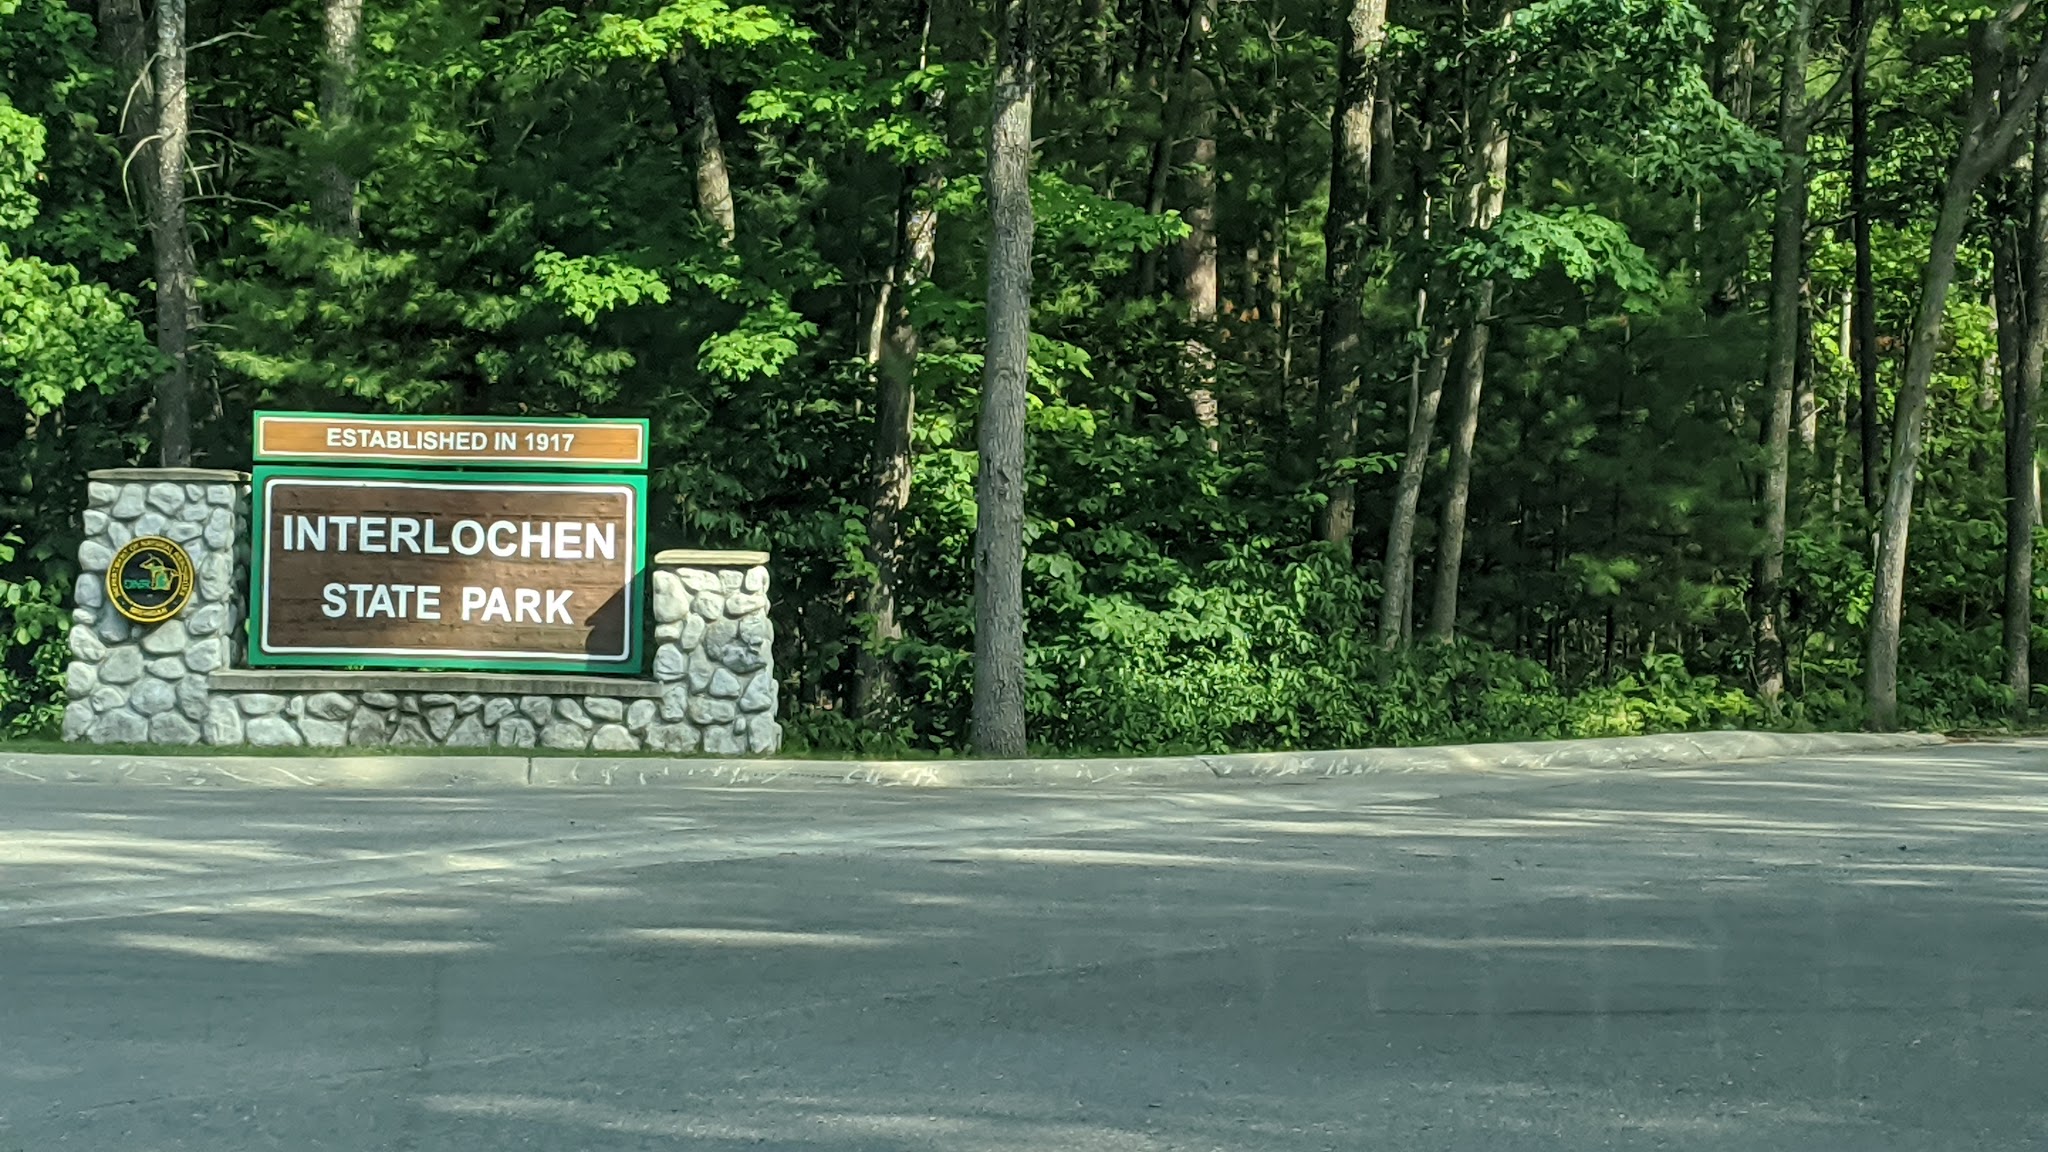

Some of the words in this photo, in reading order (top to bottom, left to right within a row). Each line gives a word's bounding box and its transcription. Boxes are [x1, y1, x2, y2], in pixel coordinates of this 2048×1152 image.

[326, 427, 489, 451] ESTABLISHED
[493, 430, 517, 452] IN
[524, 432, 575, 453] 1917
[282, 514, 616, 561] INTERLOCHEN
[321, 582, 441, 620] STATE
[461, 586, 575, 625] PARK
